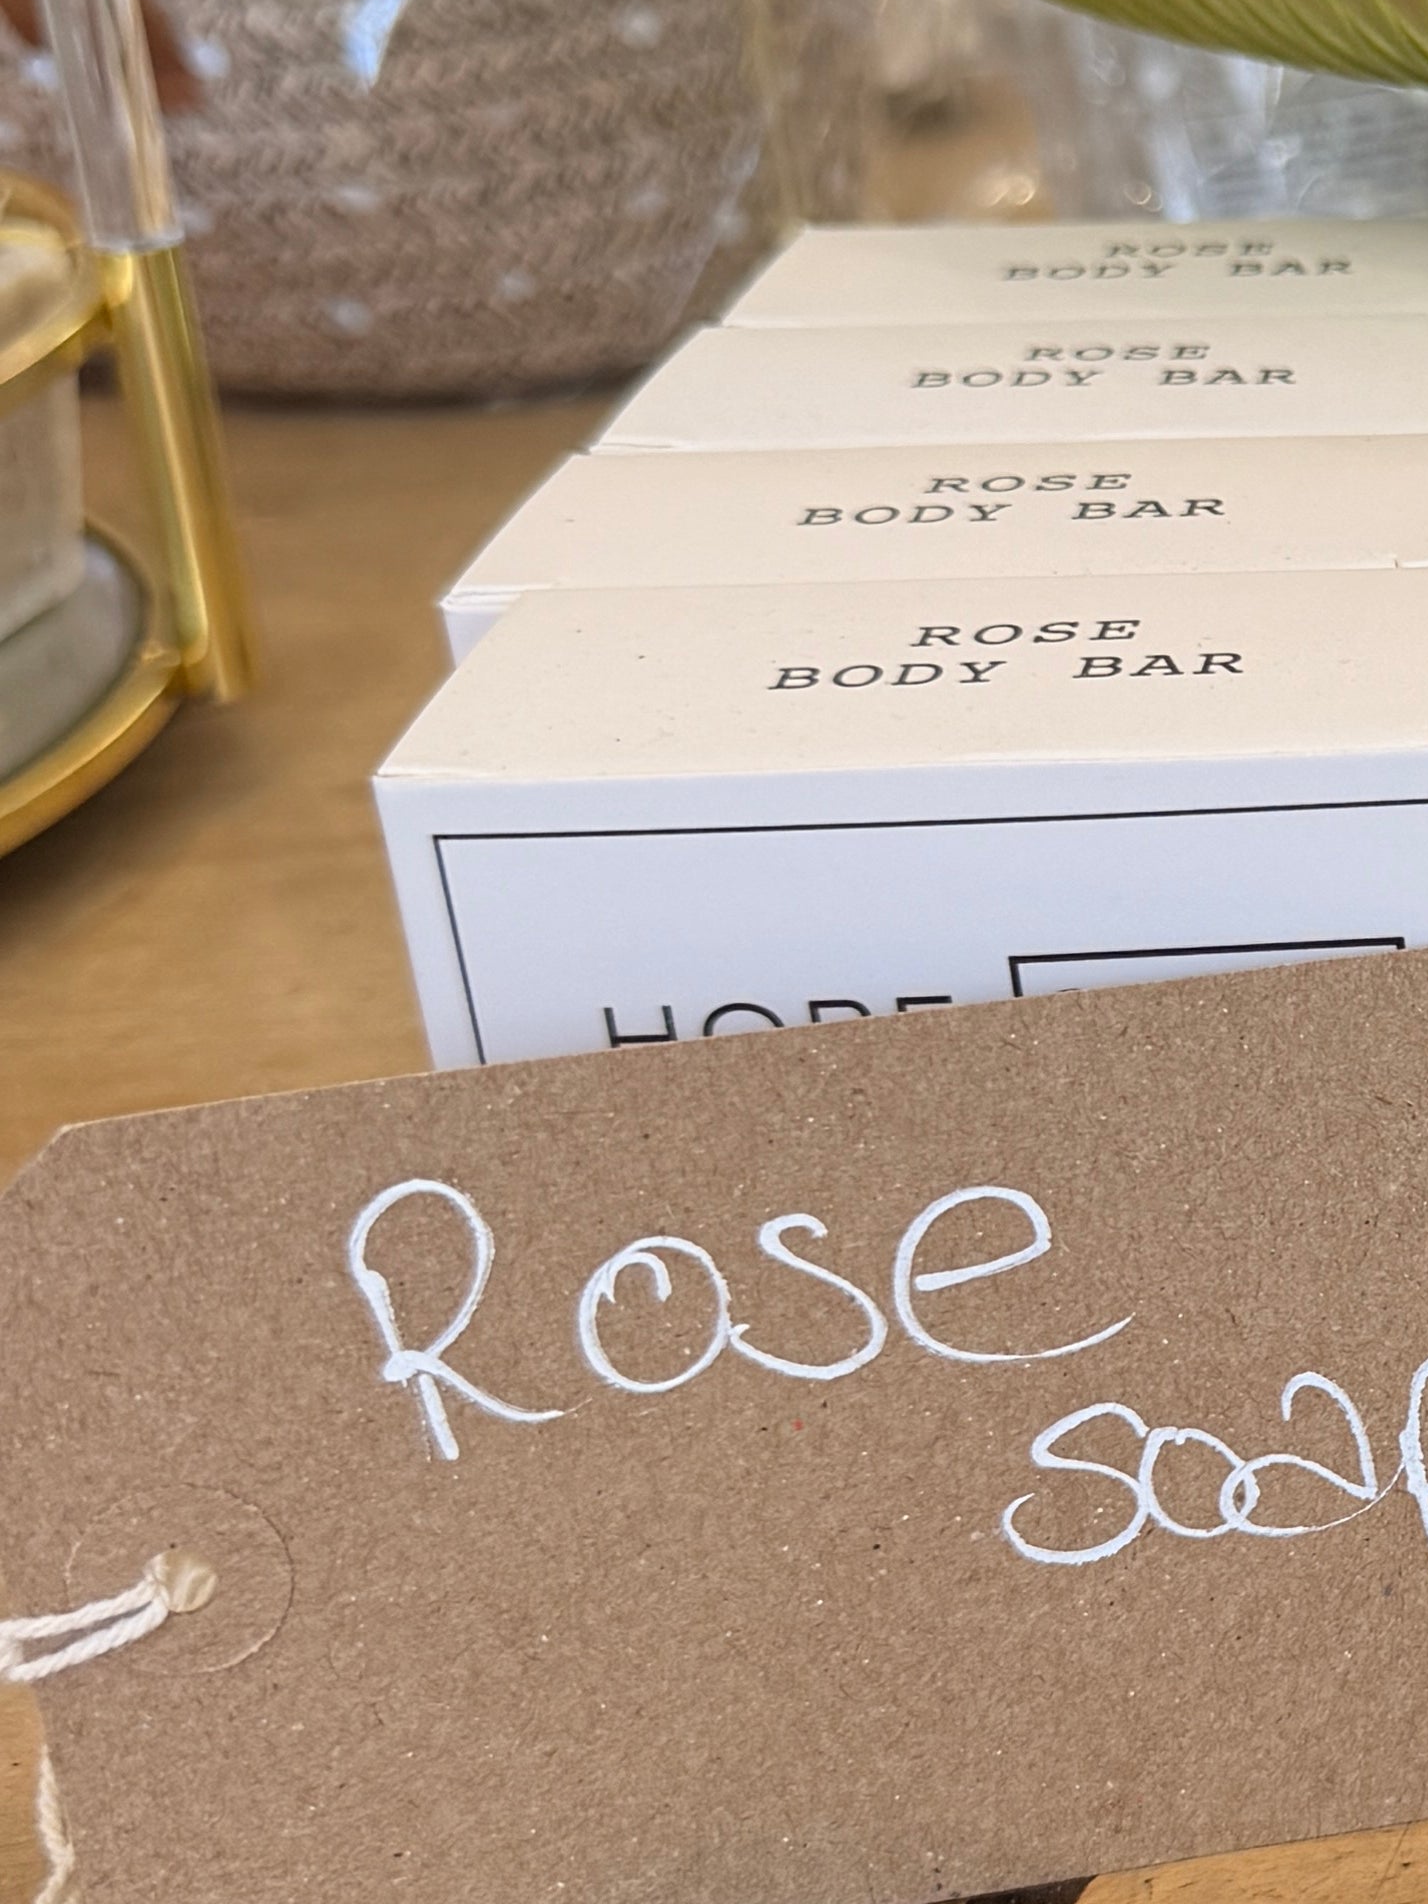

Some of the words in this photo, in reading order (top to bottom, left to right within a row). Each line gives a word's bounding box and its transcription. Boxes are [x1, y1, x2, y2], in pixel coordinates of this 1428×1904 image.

[1105, 239, 1275, 258] ROSE
[1001, 263, 1175, 282] BODY
[1228, 259, 1355, 278] BAR
[1024, 344, 1211, 362] ROSE
[910, 370, 1104, 389] BODY
[1157, 368, 1297, 387] BAR
[923, 472, 1133, 495] ROSE
[795, 503, 1014, 527] BODY
[1070, 498, 1226, 521] BAR
[909, 618, 1142, 648] ROSE
[767, 660, 1008, 691] BODY
[1071, 652, 1245, 680] BAR
[346, 1176, 1136, 1461] Rose
